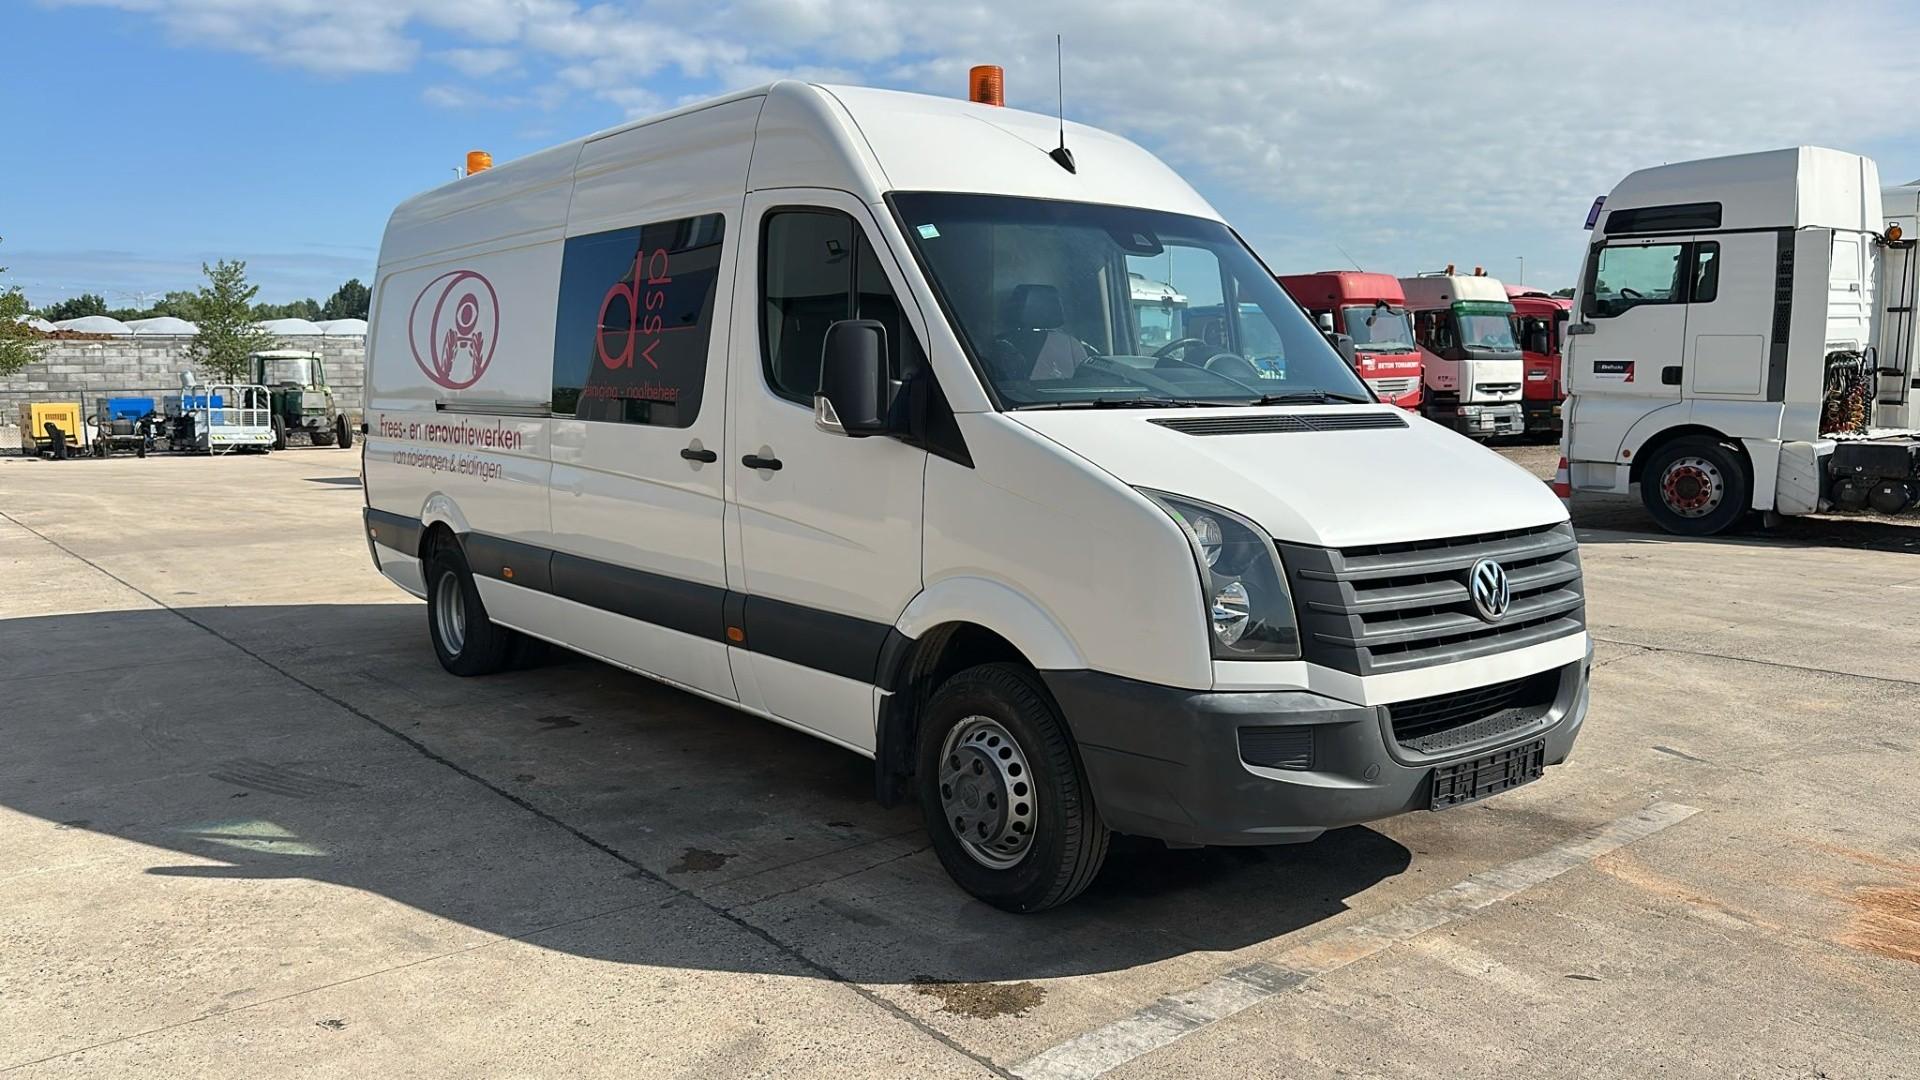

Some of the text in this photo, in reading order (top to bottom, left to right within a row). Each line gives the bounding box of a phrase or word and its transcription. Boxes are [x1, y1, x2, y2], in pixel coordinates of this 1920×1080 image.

[380, 414, 522, 450] Frees- en renovatiewerken
[393, 450, 406, 464] van
[449, 454, 457, 473] &
[458, 455, 502, 481] leidingen
